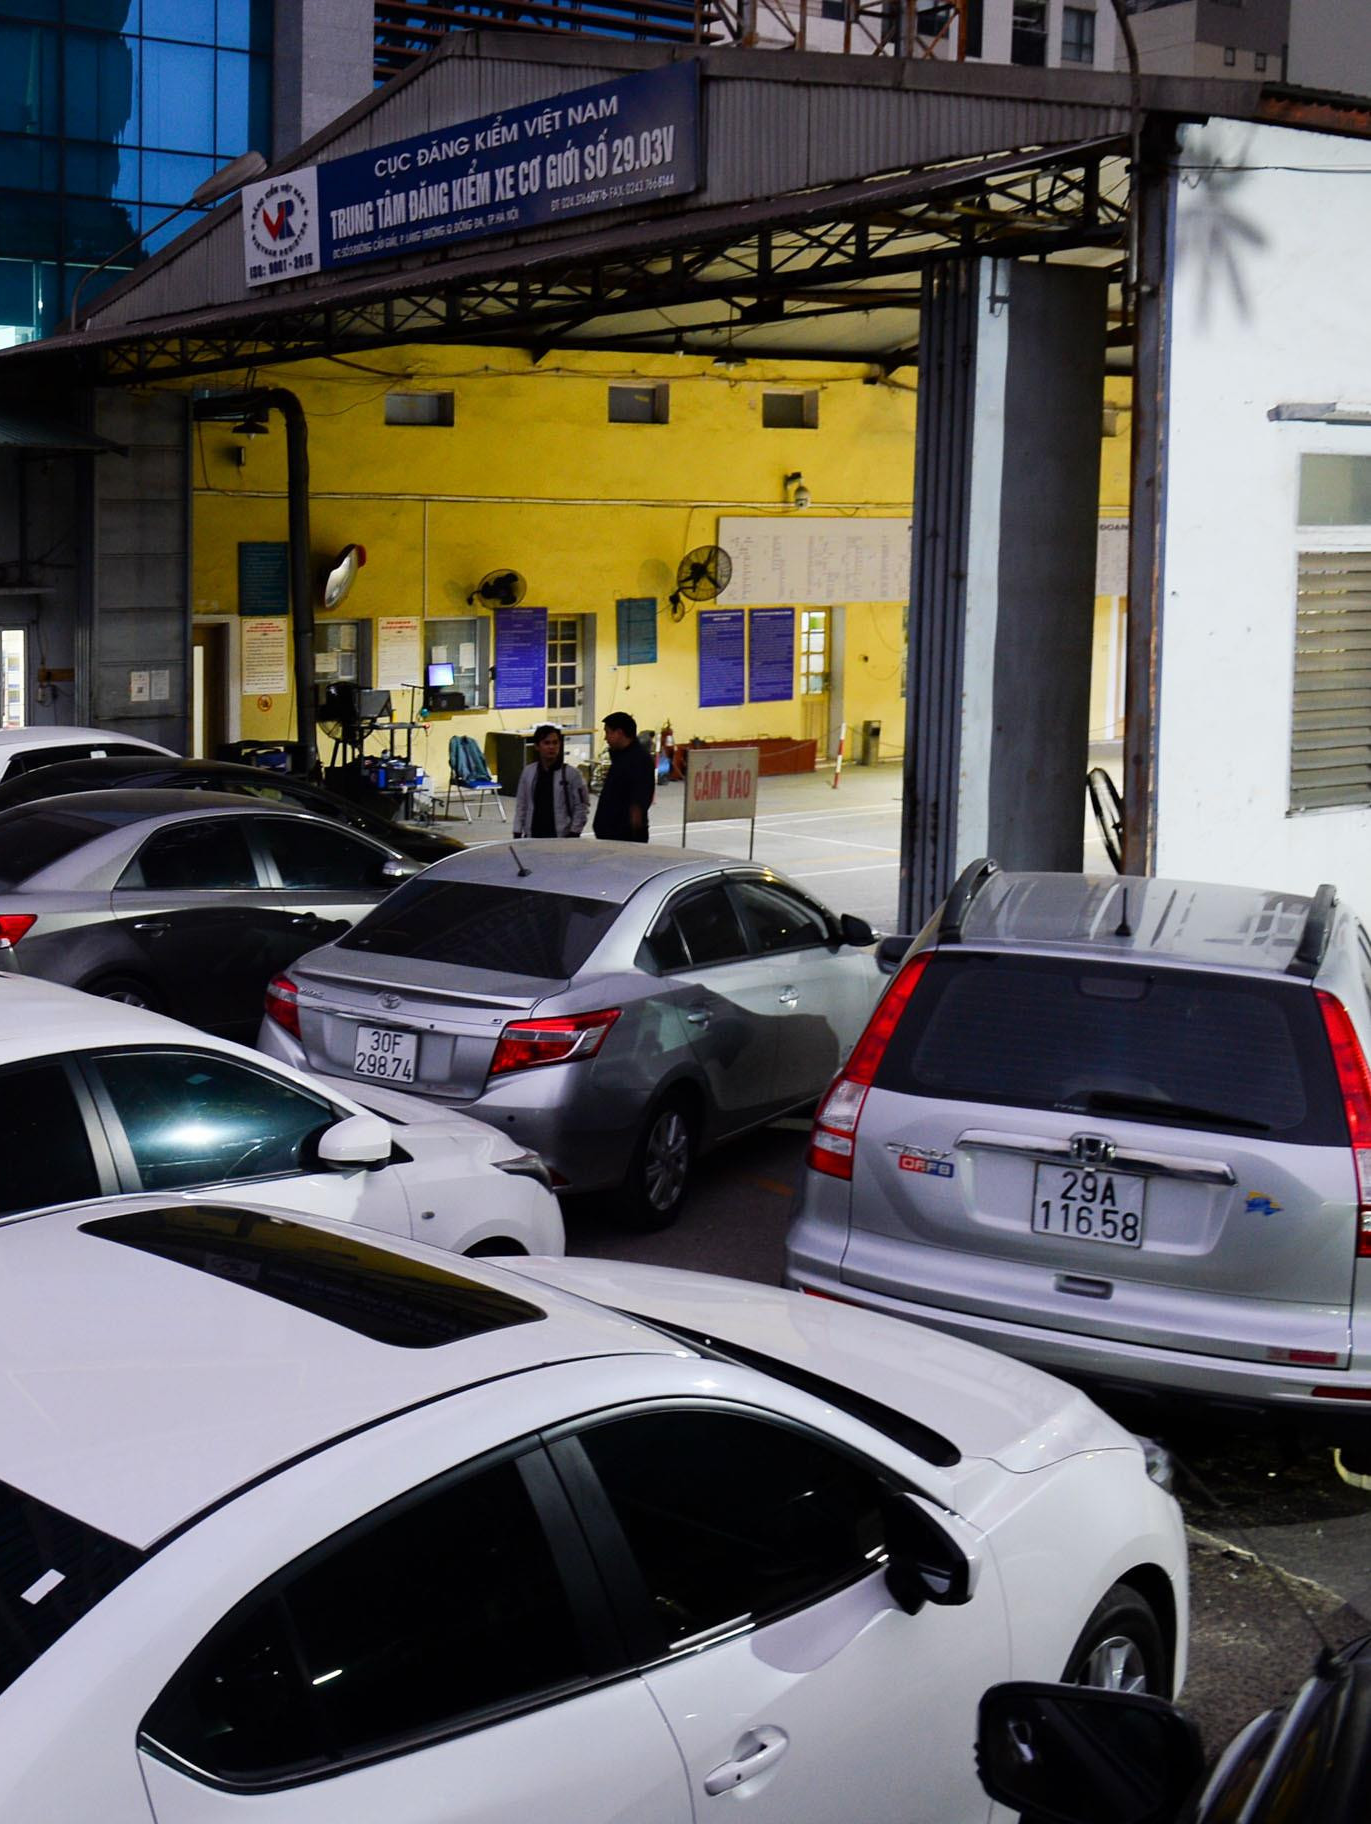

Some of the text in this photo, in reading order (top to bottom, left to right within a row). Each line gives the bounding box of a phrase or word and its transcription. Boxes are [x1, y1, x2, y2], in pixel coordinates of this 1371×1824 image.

[374, 95, 618, 179] CỤC ĐĂNG KIỂM VIỆT NAM
[330, 125, 675, 240] TRUNG TÂM ĐĂNG KIỂM XE CƠ GIỚI SỐ 29.03V
[694, 761, 751, 801] CẤM VÀO
[370, 1031, 403, 1054] 30F
[356, 1052, 412, 1081] 298.74
[1060, 1171, 1116, 1207] 29A
[1041, 1200, 1139, 1242] 116.58
